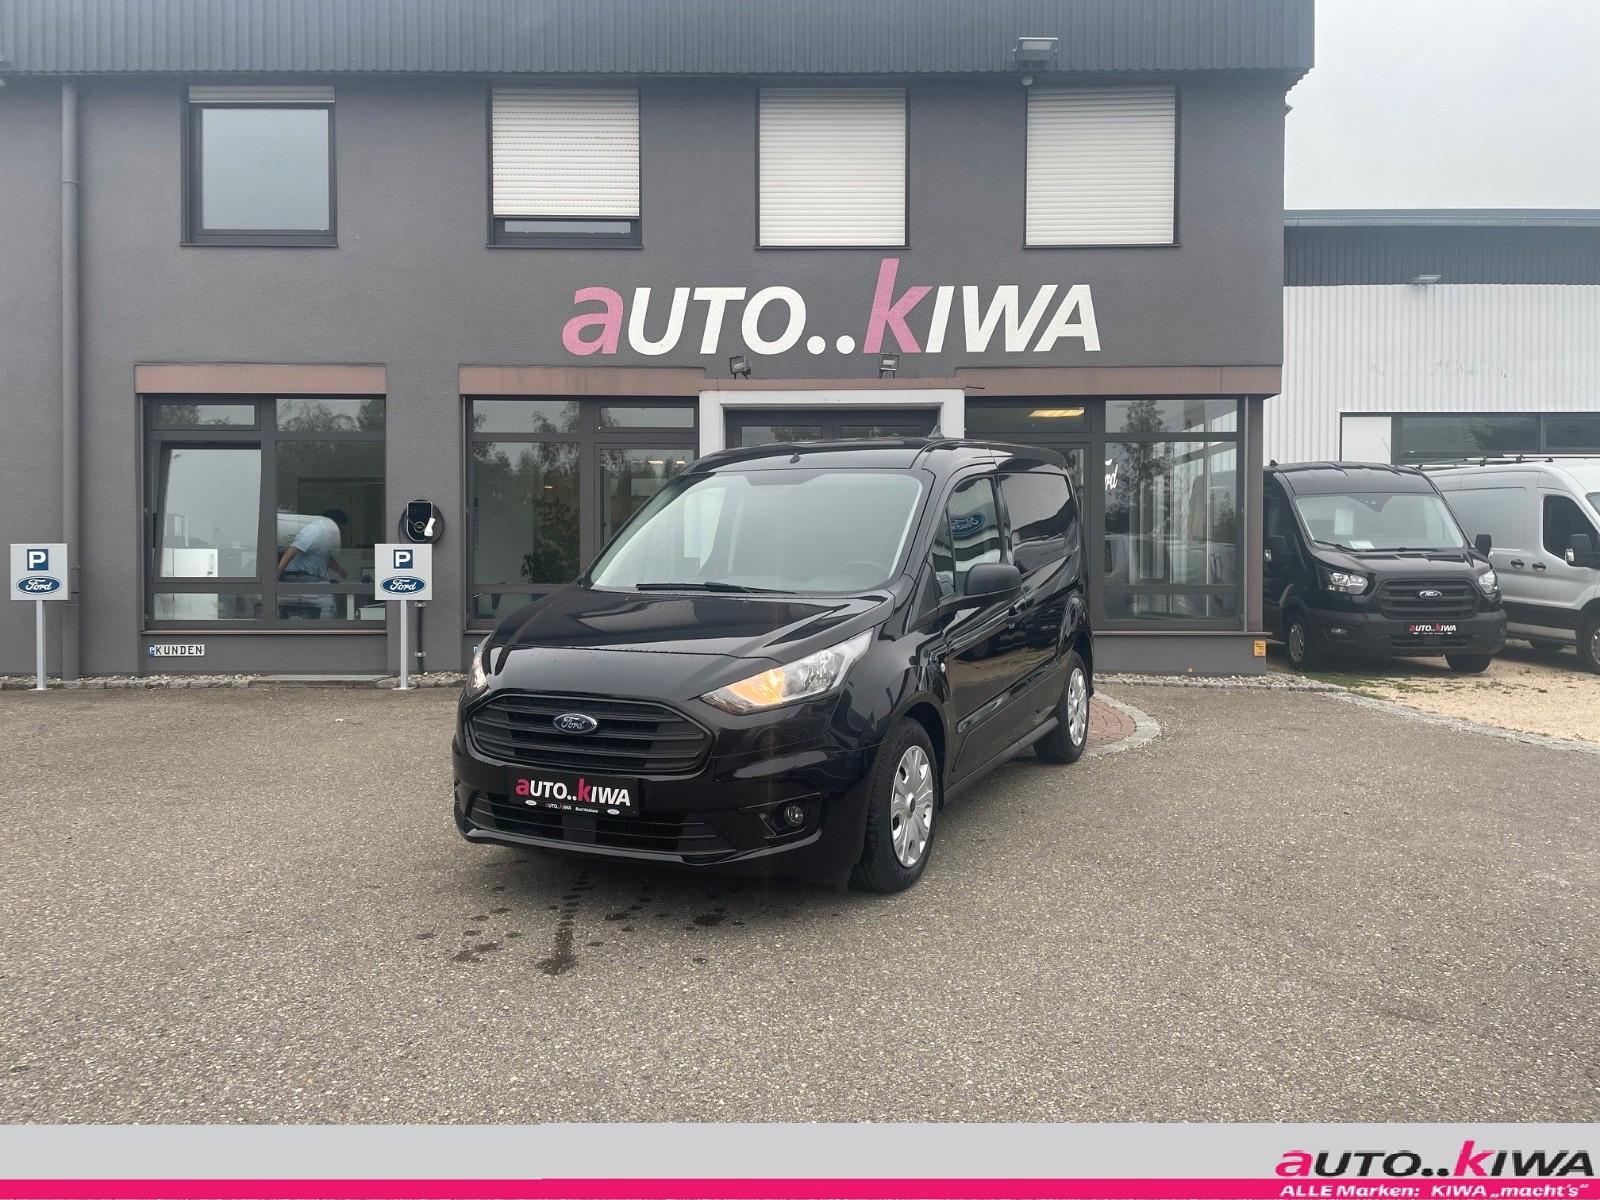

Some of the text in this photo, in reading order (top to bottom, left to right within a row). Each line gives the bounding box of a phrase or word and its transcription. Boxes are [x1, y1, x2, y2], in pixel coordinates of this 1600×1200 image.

[29, 551, 46, 568] P
[395, 551, 411, 567] P
[25, 579, 53, 591] Ford
[389, 579, 417, 591] Ford
[156, 645, 203, 655] KUNDEN
[560, 716, 586, 730] Ford
